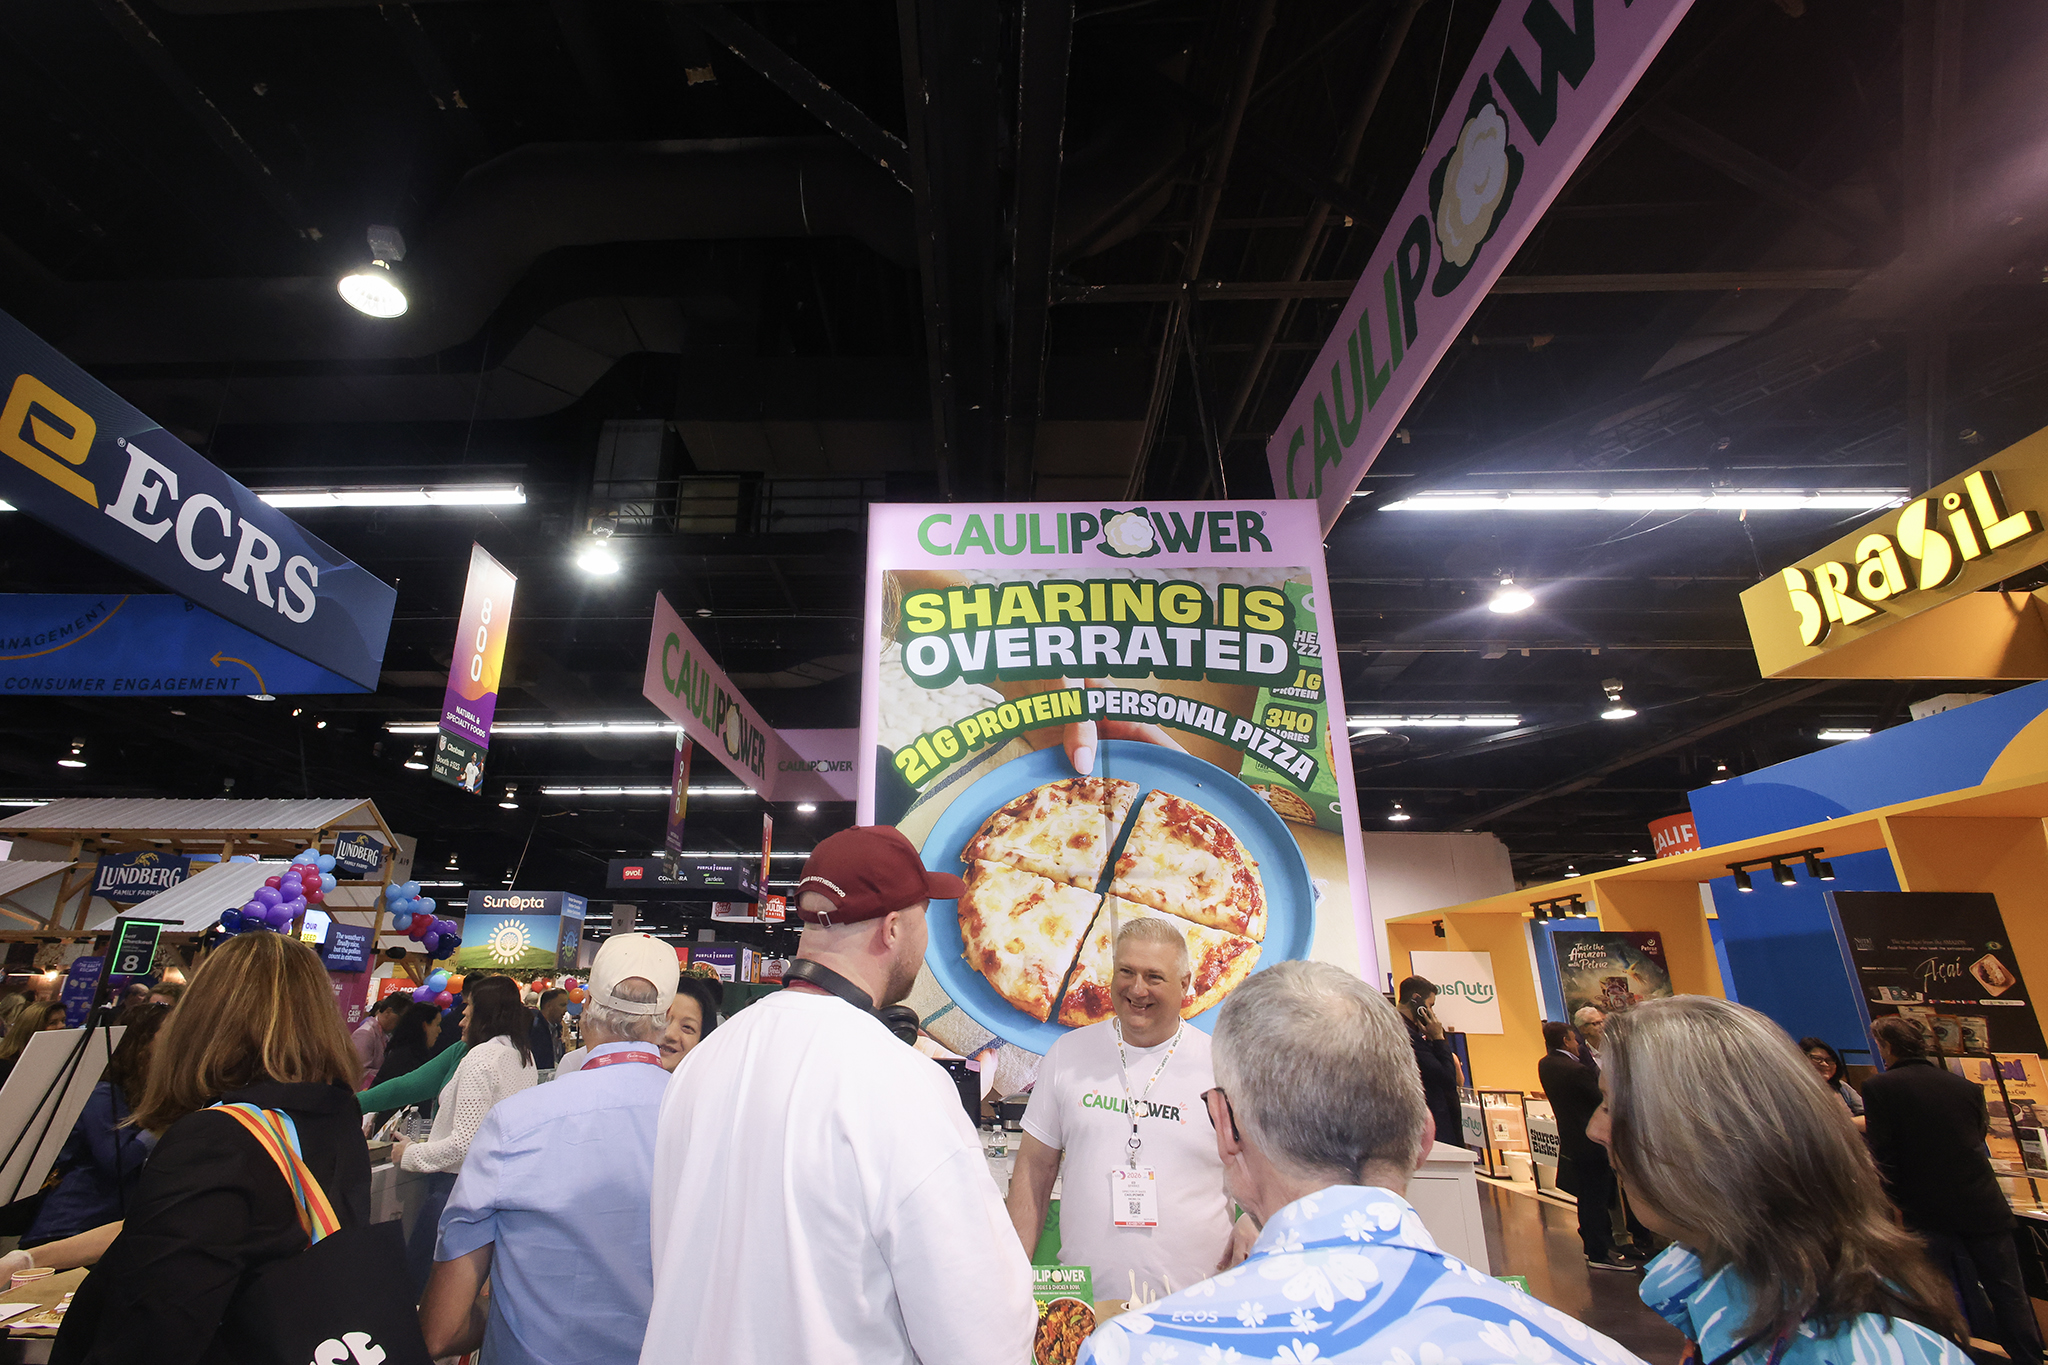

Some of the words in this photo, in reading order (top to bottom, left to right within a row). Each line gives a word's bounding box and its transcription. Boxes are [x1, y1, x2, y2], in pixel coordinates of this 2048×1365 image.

[1286, 0, 1640, 499] CAULIPOW
[104, 441, 320, 624] ECRS
[917, 507, 1273, 558] CAULIPOWER
[905, 582, 1203, 634] SHARING
[1222, 587, 1286, 631] IS
[470, 597, 493, 682] 800
[905, 625, 1289, 677] OVERRATED
[4, 677, 106, 691] CONSUMER
[112, 676, 241, 692] ENGAGEMENT
[1293, 669, 1322, 690] 1G
[455, 705, 476, 723] NATURAL
[661, 631, 766, 781] CAULIPOWER
[446, 711, 470, 730] SPECIALTY
[469, 723, 486, 739] FOODS
[1265, 707, 1314, 733] 340
[895, 727, 960, 782] 21G
[957, 690, 1083, 746] PROTEIN
[1086, 689, 1227, 738] PERSONAL
[1231, 718, 1317, 783] PIZZA
[1266, 726, 1310, 744] ALORIES
[777, 759, 853, 773] CAULIPOWER
[675, 760, 685, 815] 900
[335, 839, 380, 867] LUNDBERG
[96, 865, 182, 892] LUNDBERG
[113, 888, 136, 897] FAMILY
[136, 888, 160, 897] FARMS
[483, 895, 545, 911] SunOpta
[765, 902, 785, 918] OULDER
[1568, 947, 1607, 961] Amazon
[1575, 942, 1592, 951] Taste
[1592, 942, 1605, 951] the
[122, 954, 140, 972] 8
[1579, 958, 1608, 970] Petruz
[1913, 956, 1963, 993] Açaí
[1530, 1128, 1560, 1146] Surrea
[1033, 1269, 1086, 1283] LIPOWER
[1171, 1309, 1219, 1324] ECOS
